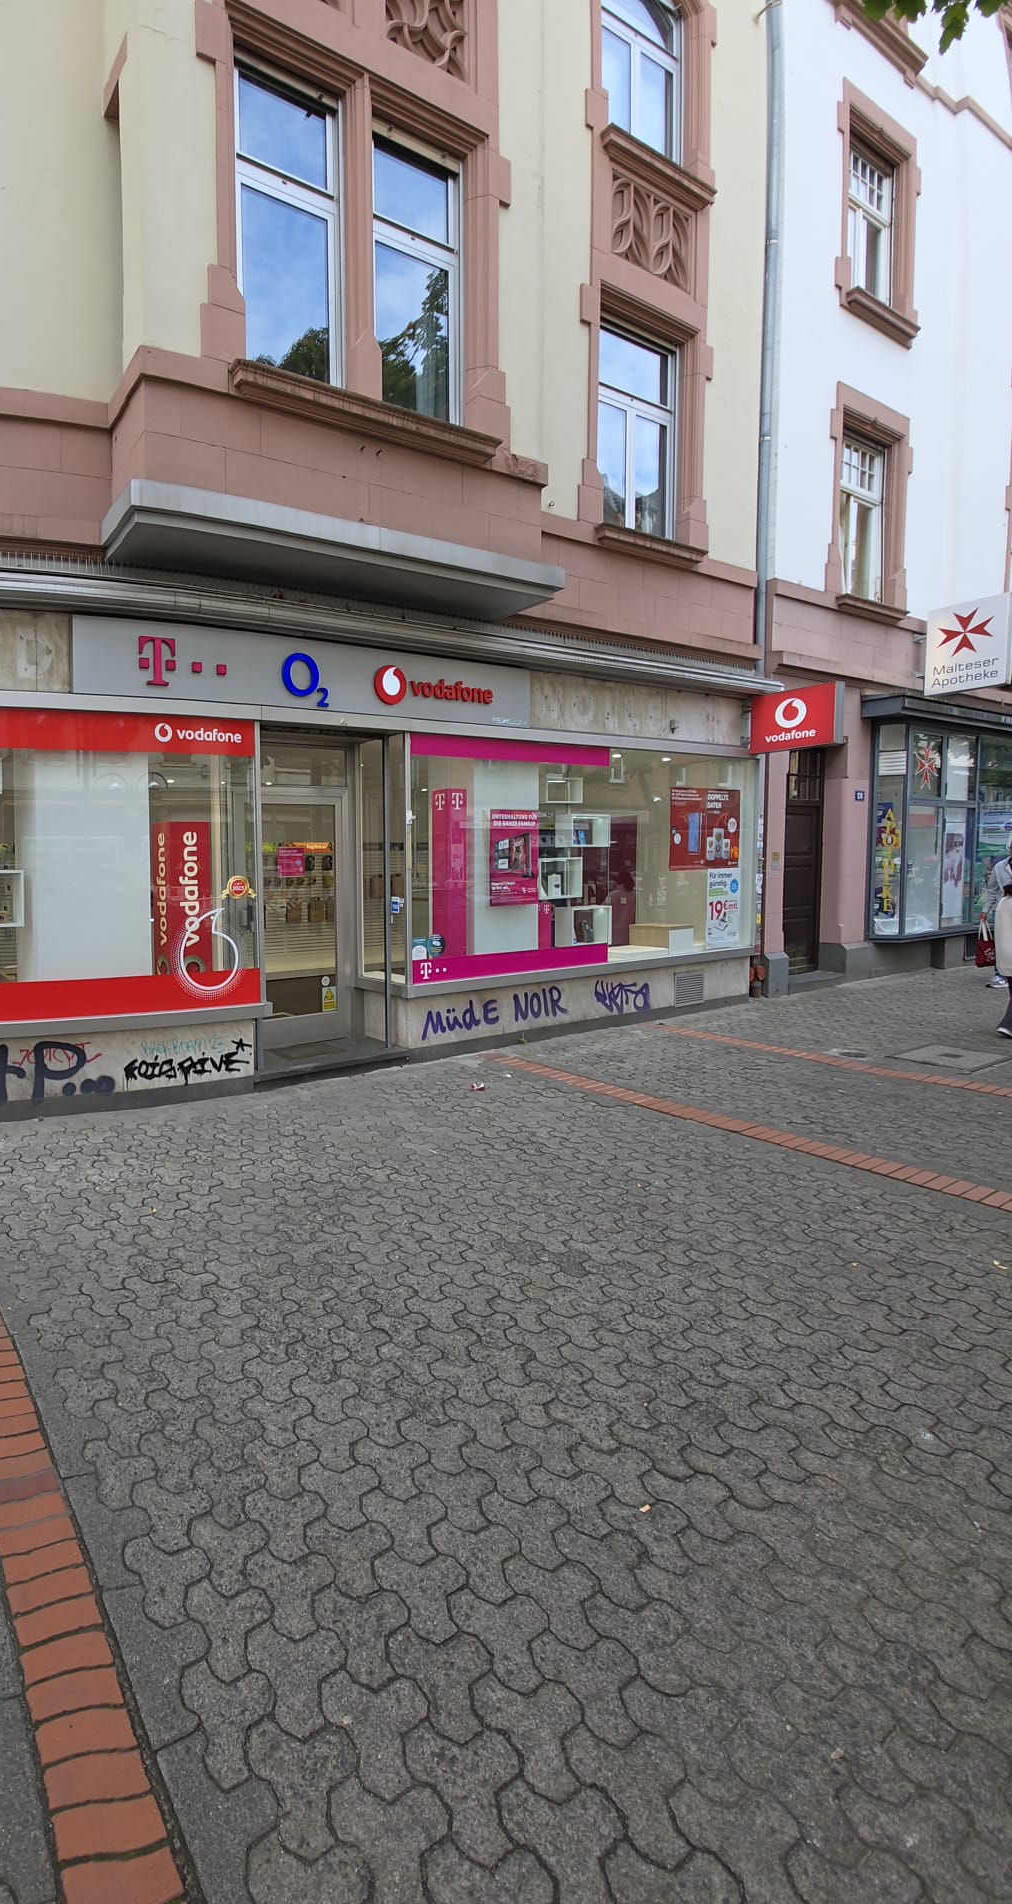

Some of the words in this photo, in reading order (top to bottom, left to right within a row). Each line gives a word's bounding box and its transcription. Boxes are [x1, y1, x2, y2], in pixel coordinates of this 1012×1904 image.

[933, 656, 999, 676] Malteser
[931, 669, 999, 688] Apotheke
[410, 679, 493, 704] vodafone
[176, 728, 243, 743] vodafone
[765, 728, 816, 742] vodafone
[156, 832, 167, 946] vodafone
[180, 831, 200, 947] vodafone
[513, 985, 568, 1022] NOIR
